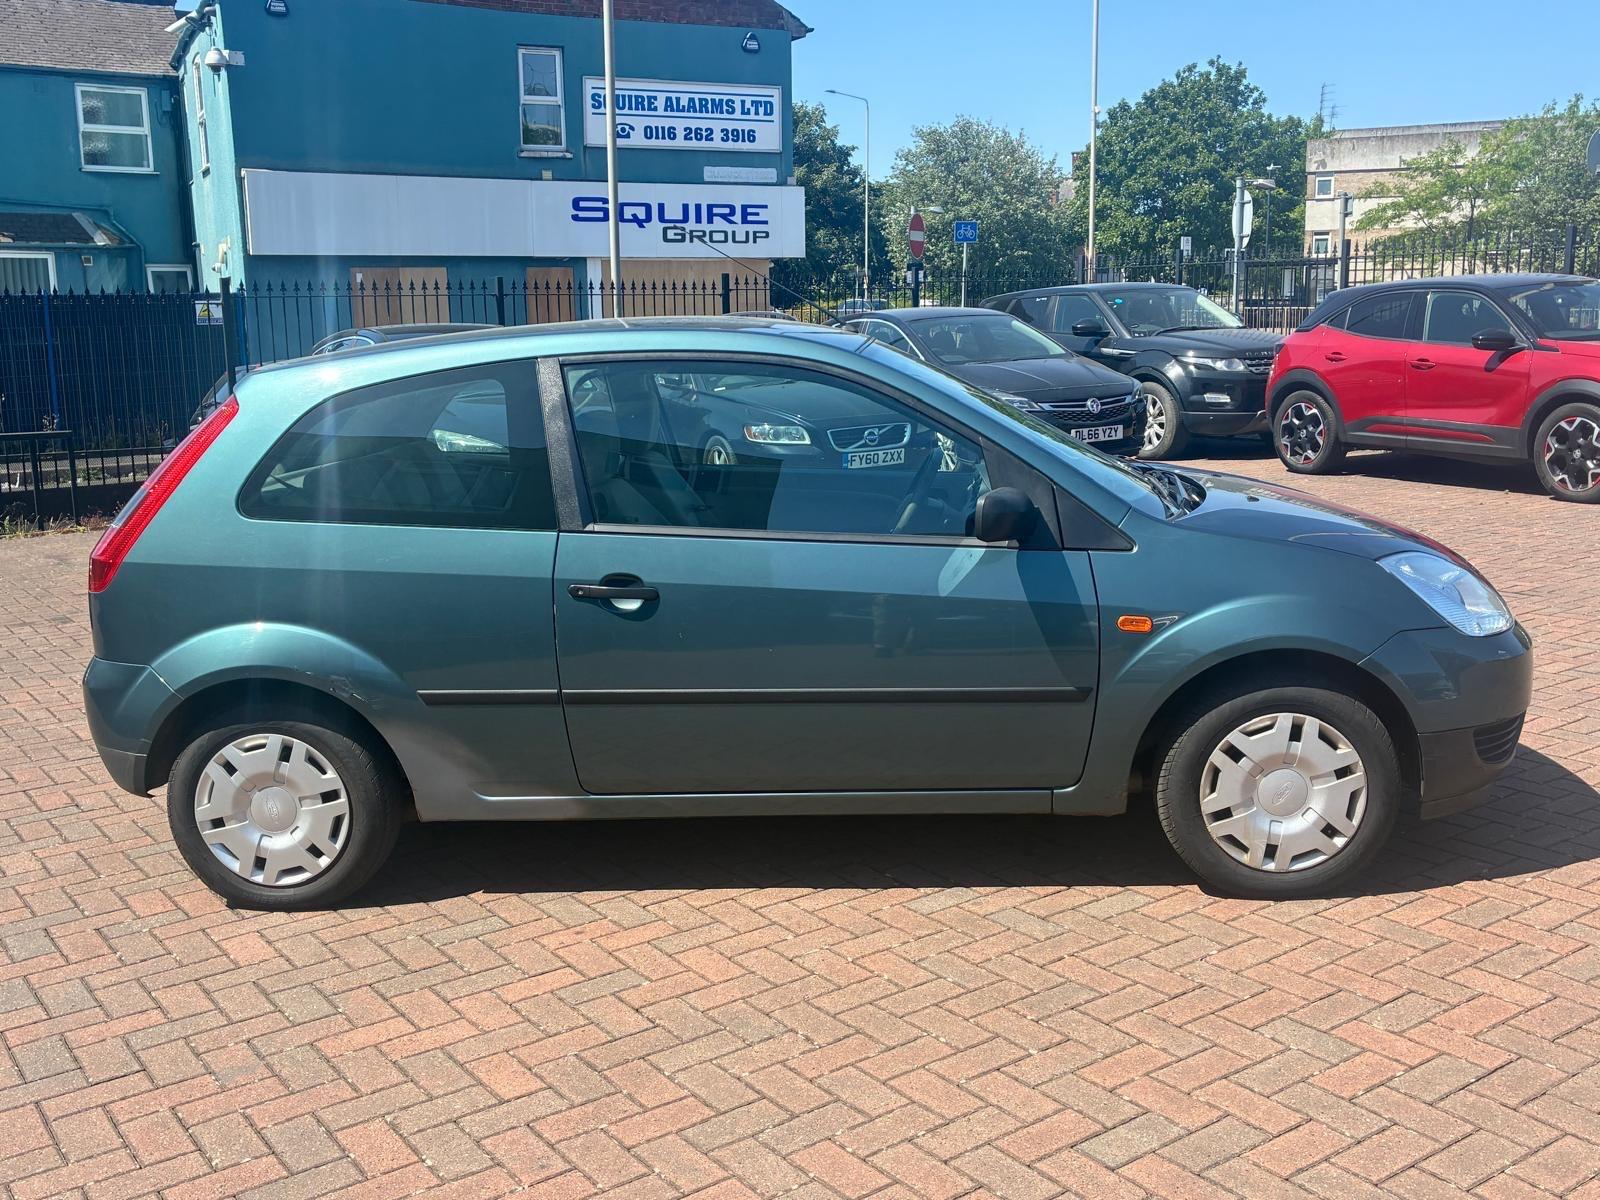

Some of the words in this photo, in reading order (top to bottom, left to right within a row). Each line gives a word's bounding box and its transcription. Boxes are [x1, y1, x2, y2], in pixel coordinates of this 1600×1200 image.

[591, 92, 658, 112] SUIRE
[663, 96, 736, 115] ALARMS
[740, 99, 774, 116] LTD
[643, 125, 677, 141] 0116
[683, 127, 714, 142] 262
[720, 128, 757, 144] 3916
[571, 196, 769, 229] SQUIRE
[1102, 426, 1119, 439] YZY
[850, 452, 880, 467] FY60
[882, 450, 903, 464] ZXX
